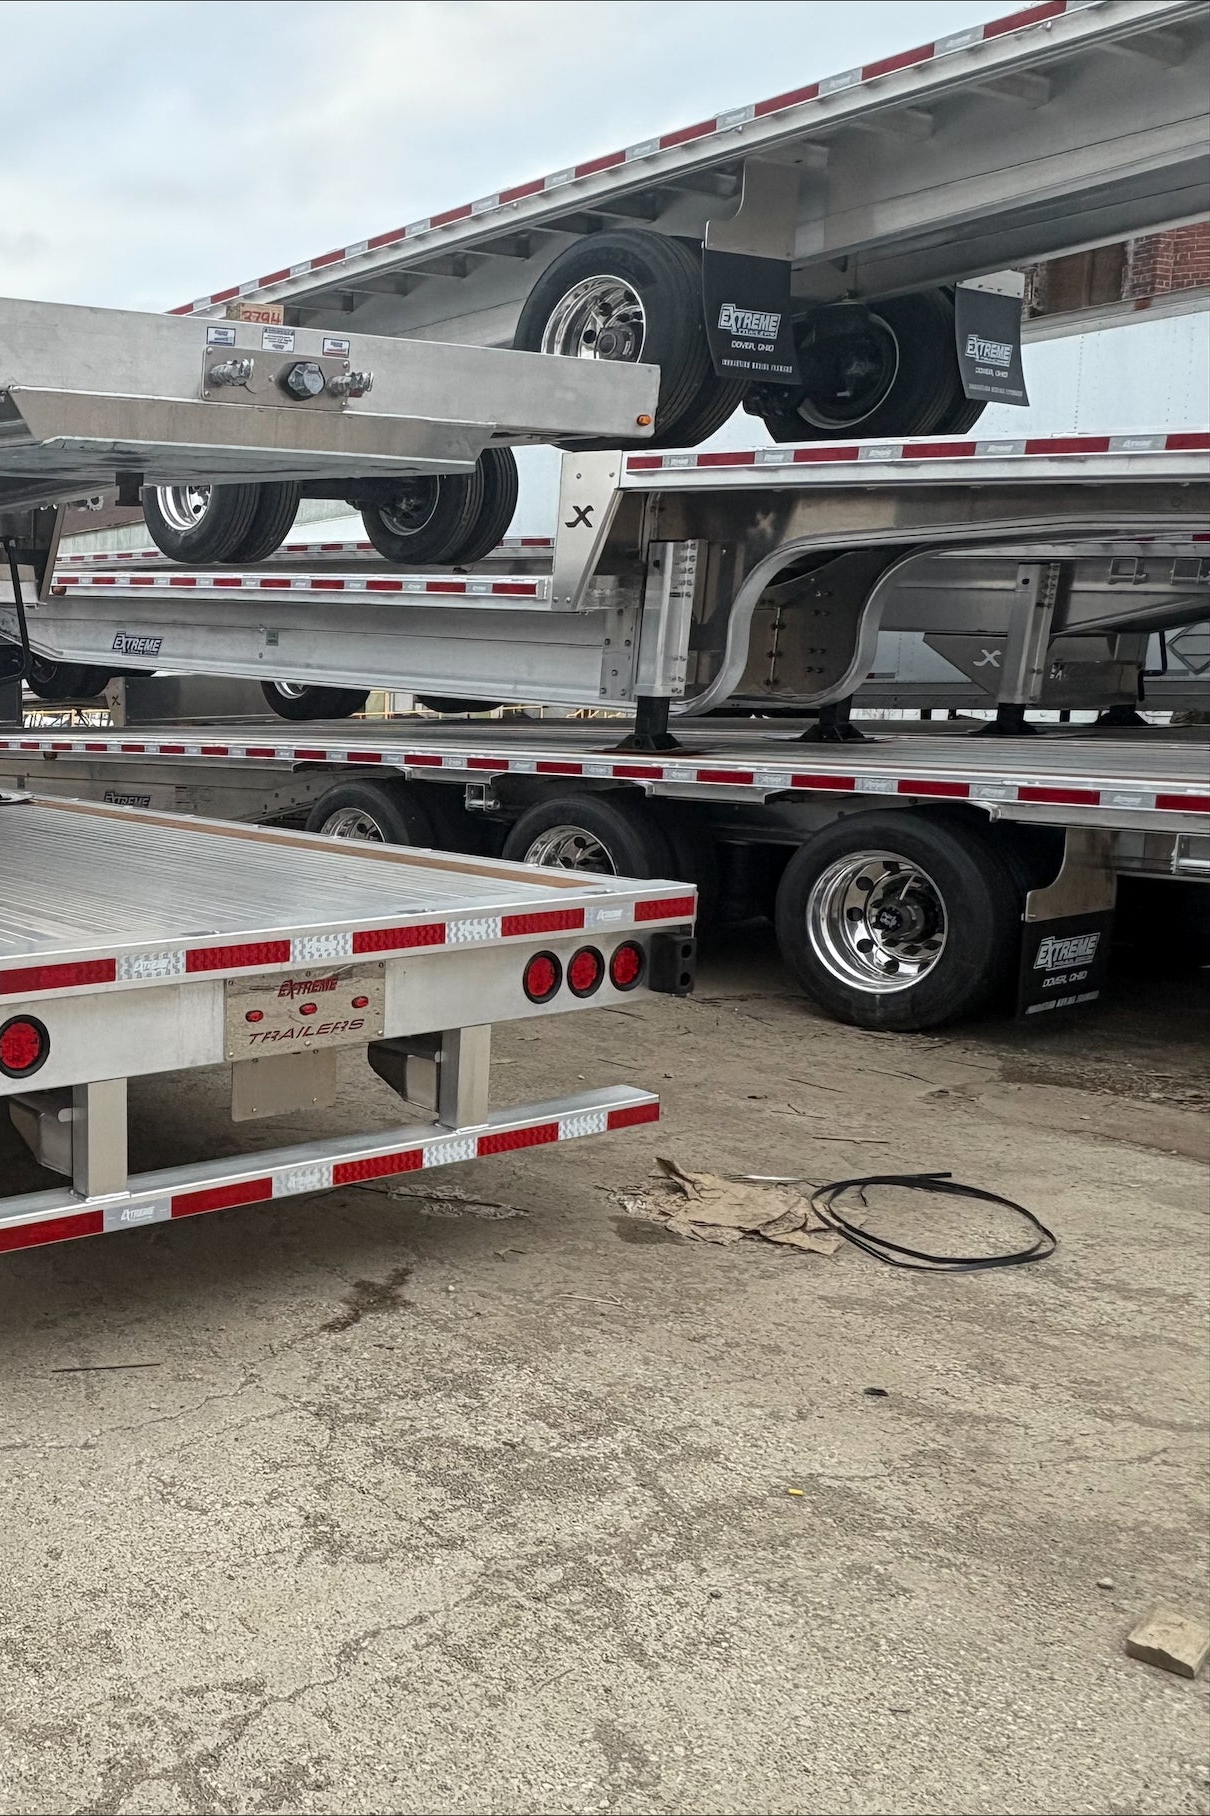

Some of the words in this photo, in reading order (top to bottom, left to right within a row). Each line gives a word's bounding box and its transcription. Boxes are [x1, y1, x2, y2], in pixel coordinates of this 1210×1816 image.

[243, 310, 281, 325] 2794
[720, 306, 779, 333] EXTREME
[967, 336, 1011, 360] EXTREME
[113, 634, 161, 653] EXTREME
[1036, 935, 1098, 968] EXTREME
[277, 976, 339, 999] EXTREME
[248, 1019, 365, 1045] TRAILERS
